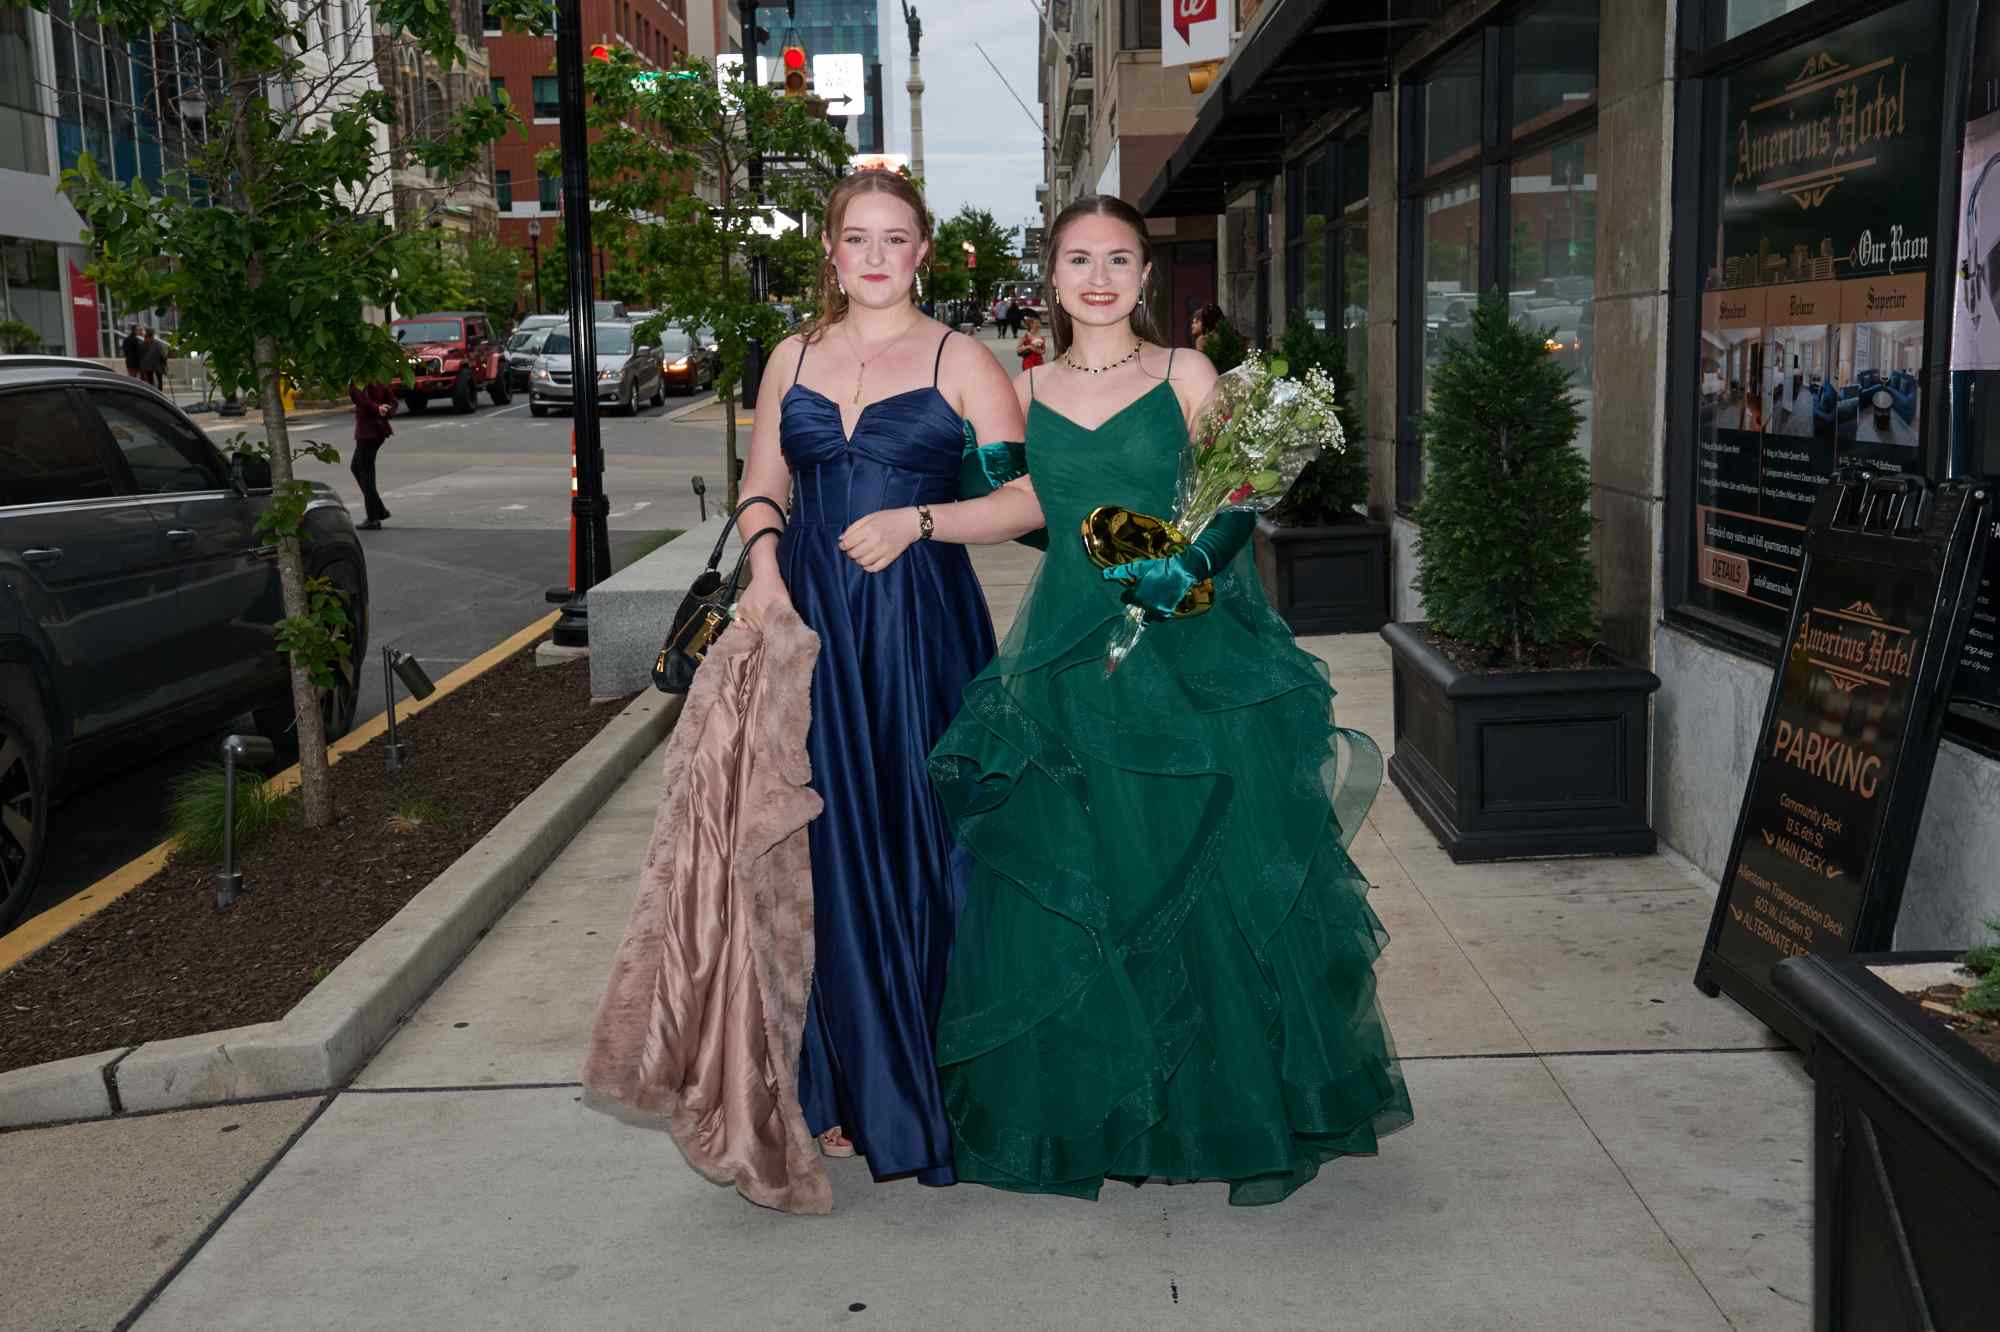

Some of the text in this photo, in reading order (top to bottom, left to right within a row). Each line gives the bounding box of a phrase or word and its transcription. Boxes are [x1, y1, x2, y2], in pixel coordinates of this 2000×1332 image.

[1733, 64, 1906, 198] Americus Hotel
[1859, 229, 1886, 267] Our
[1866, 286, 1907, 317] Superior
[1712, 558, 1741, 583] DETAILS
[1791, 611, 1918, 678] Americus Hotel
[1773, 720, 1881, 799] PARKING
[1779, 793, 1842, 834] Community Deck
[1775, 834, 1826, 875] MAIN DECK
[1771, 882, 1824, 924] Transportation
[1823, 914, 1843, 938] Deck
[1778, 909, 1803, 936] Linden
[1743, 912, 1792, 954] ALTERNATE
